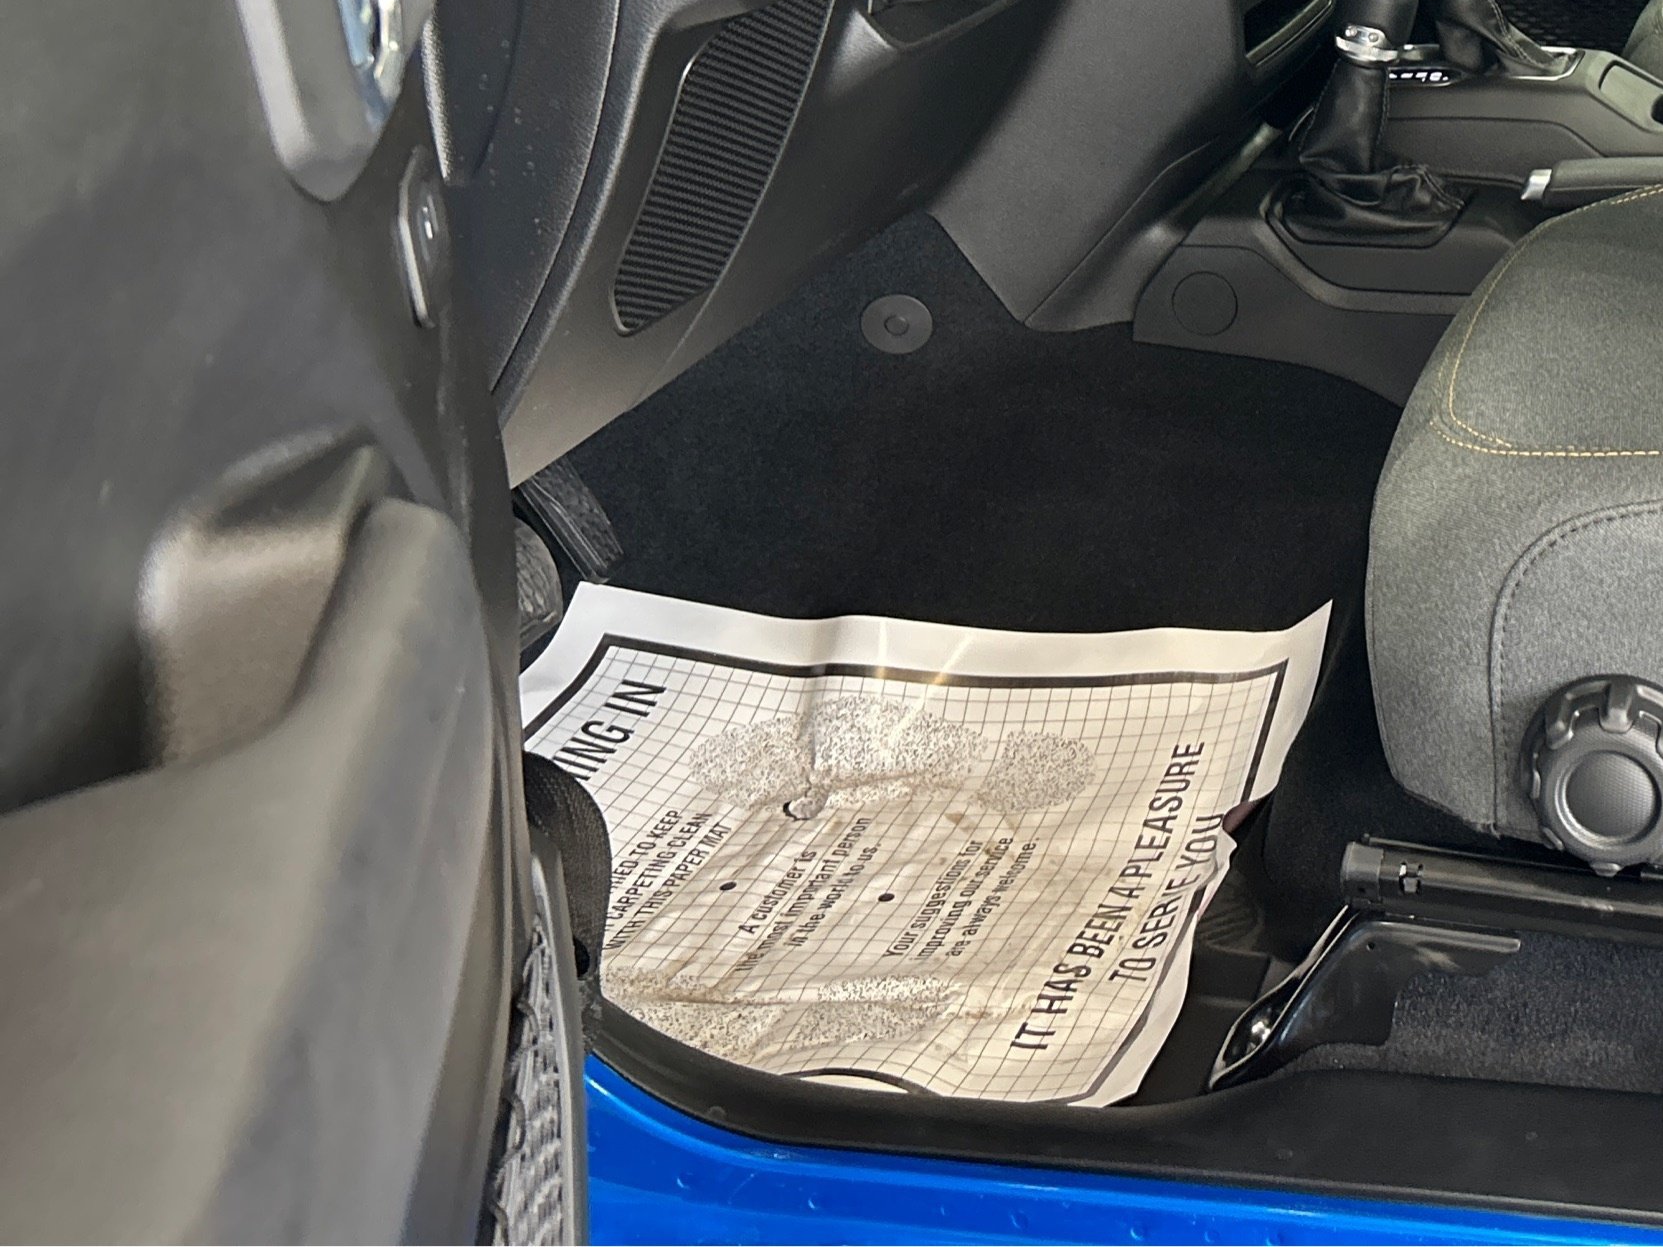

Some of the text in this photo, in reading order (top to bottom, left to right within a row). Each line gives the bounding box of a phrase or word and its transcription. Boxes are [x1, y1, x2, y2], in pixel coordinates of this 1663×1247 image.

[552, 678, 667, 781] ING IN
[602, 822, 732, 950] WITH THIS PAPER MAT
[607, 813, 713, 920] CARPETING CLEAN
[629, 841, 657, 857] TO
[646, 810, 682, 839] KEEP
[738, 850, 817, 934] A customer is
[735, 817, 872, 971] the most important person
[784, 933, 809, 947] in
[798, 913, 826, 934] the
[844, 864, 865, 878] to
[857, 842, 882, 863] us.
[882, 840, 983, 958] Your suggestions for
[909, 837, 1013, 960] improving our service
[945, 837, 1039, 957] are always welcome.
[1010, 741, 1206, 1050] IT HAS BEEN A PLEASURE
[1108, 957, 1156, 983] TO
[1175, 813, 1225, 871] YOU
